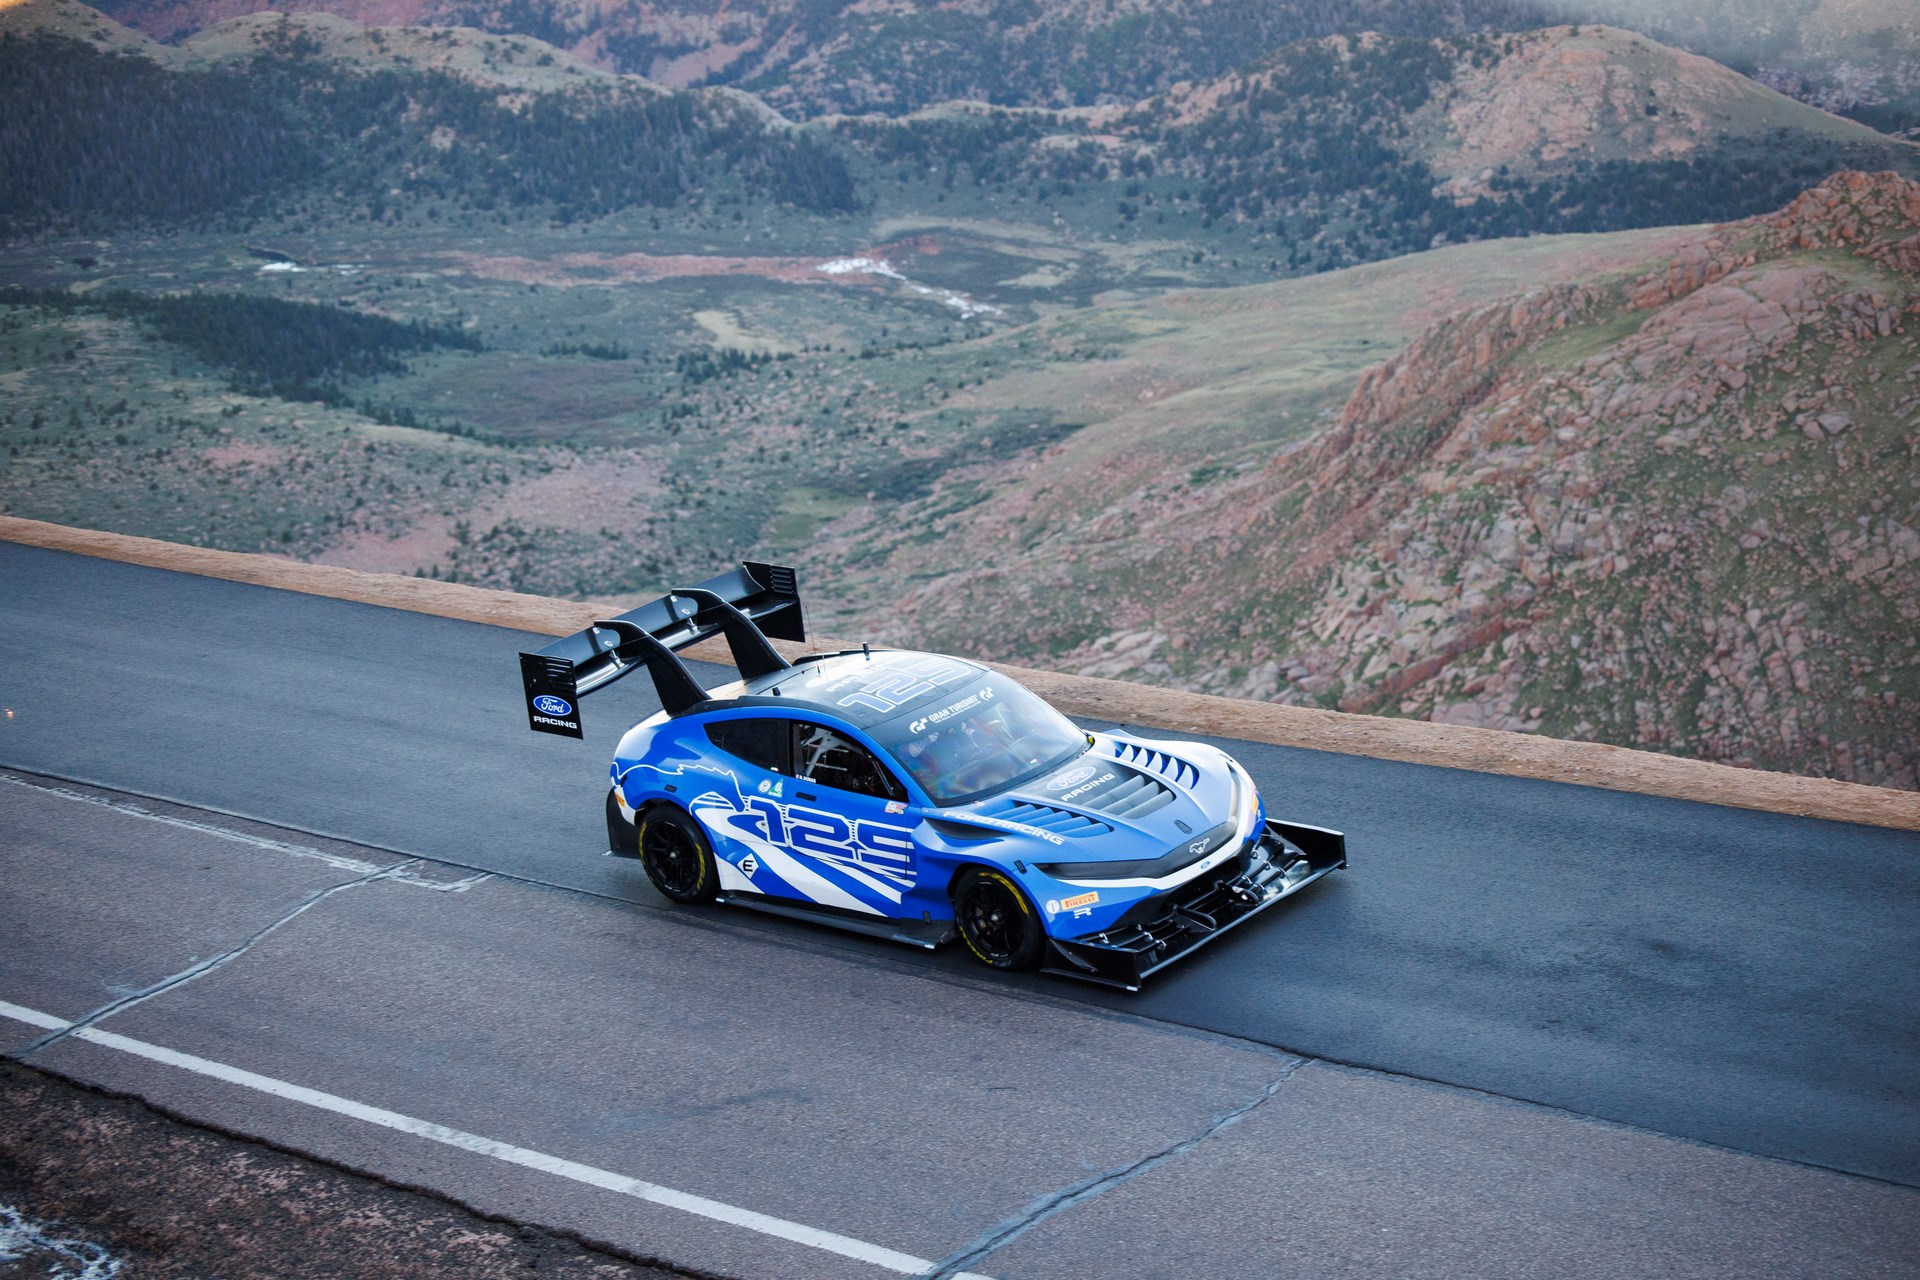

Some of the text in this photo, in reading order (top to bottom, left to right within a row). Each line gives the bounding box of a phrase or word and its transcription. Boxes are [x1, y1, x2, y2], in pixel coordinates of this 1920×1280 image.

[836, 656, 972, 714] 125
[540, 697, 565, 714] Ford
[928, 708, 951, 722] GRAN
[533, 715, 578, 730] RACING
[1060, 772, 1116, 802] RACING
[748, 795, 918, 877] 125
[992, 815, 1065, 846] RACING
[1064, 893, 1096, 909] PIRELLI
